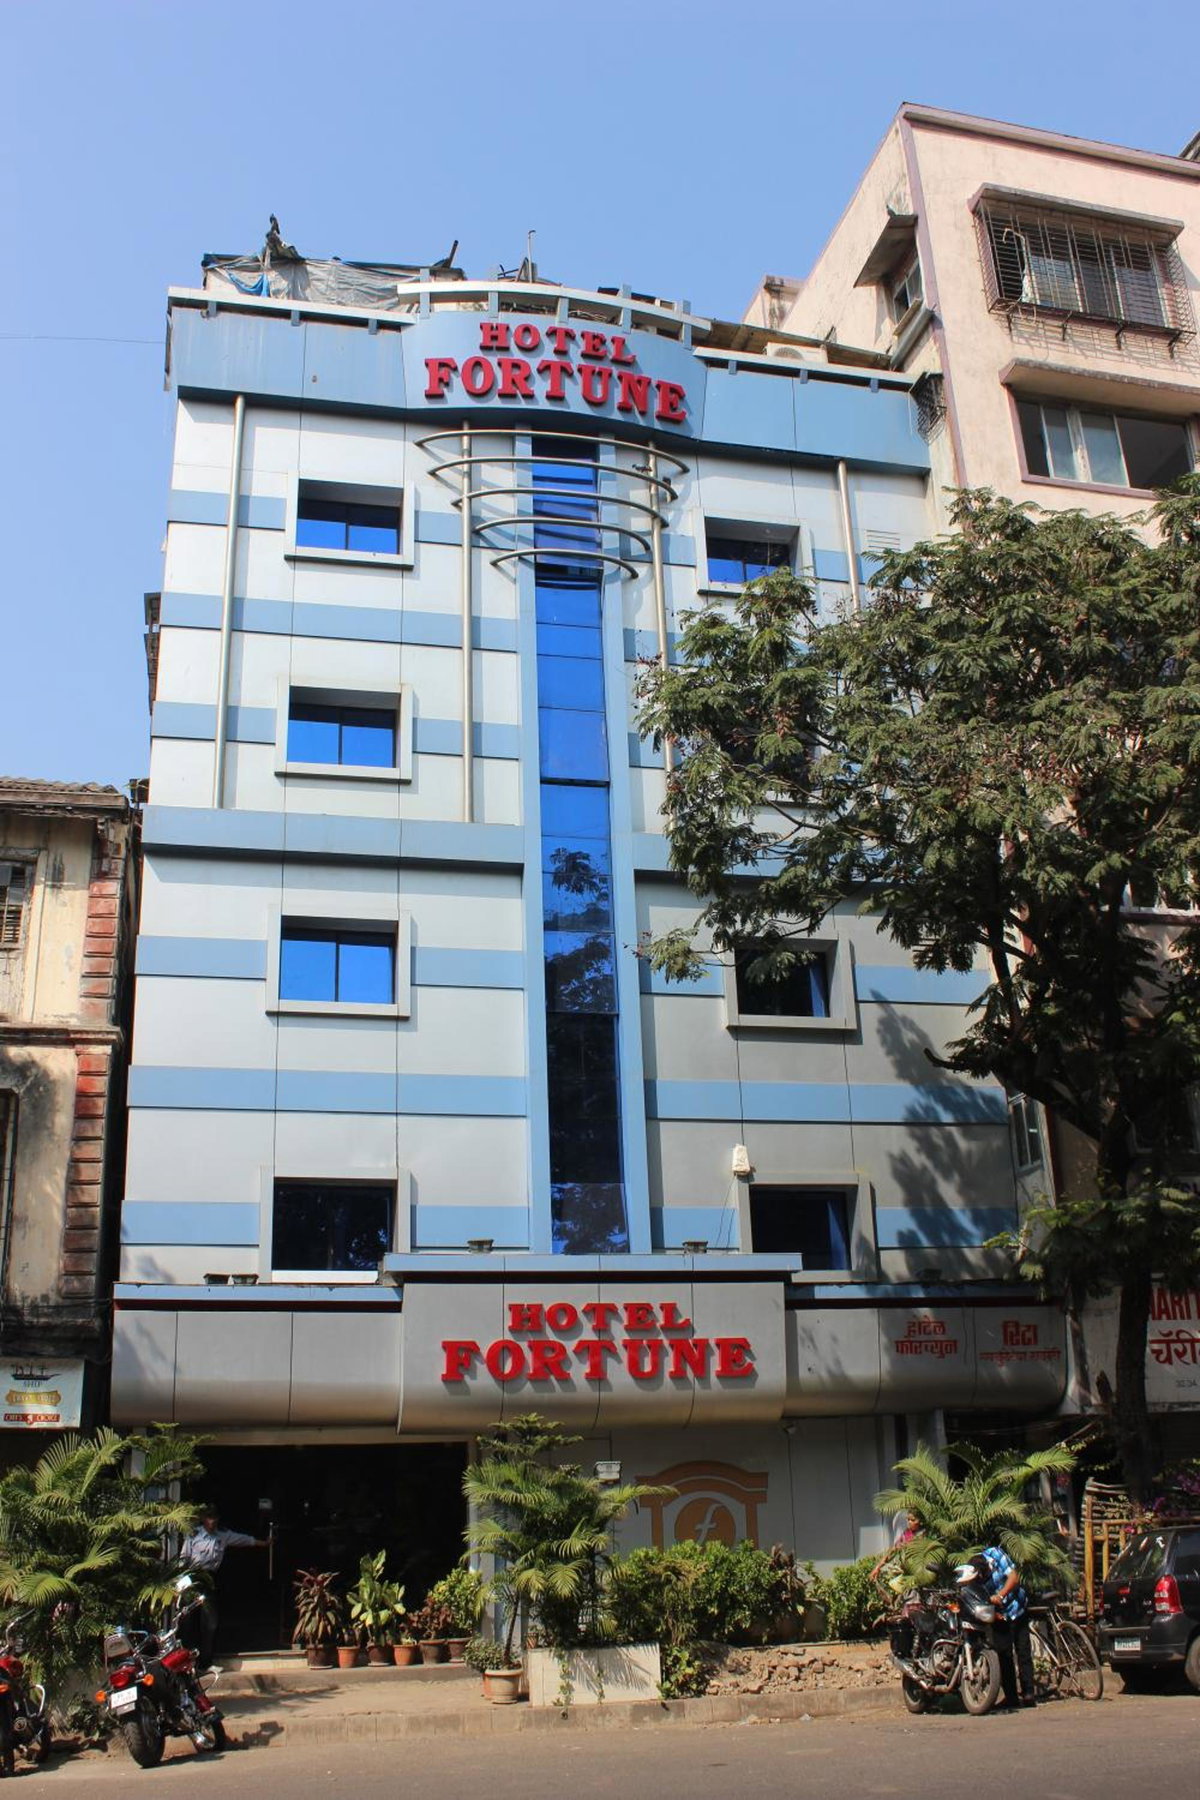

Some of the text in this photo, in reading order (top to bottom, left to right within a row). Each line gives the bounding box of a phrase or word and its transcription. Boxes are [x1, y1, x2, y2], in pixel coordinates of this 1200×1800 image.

[479, 321, 636, 365] HOTEL
[424, 356, 688, 423] FORTUNE
[508, 1302, 692, 1331] HOTEL
[441, 1337, 755, 1382] FORTUNE
